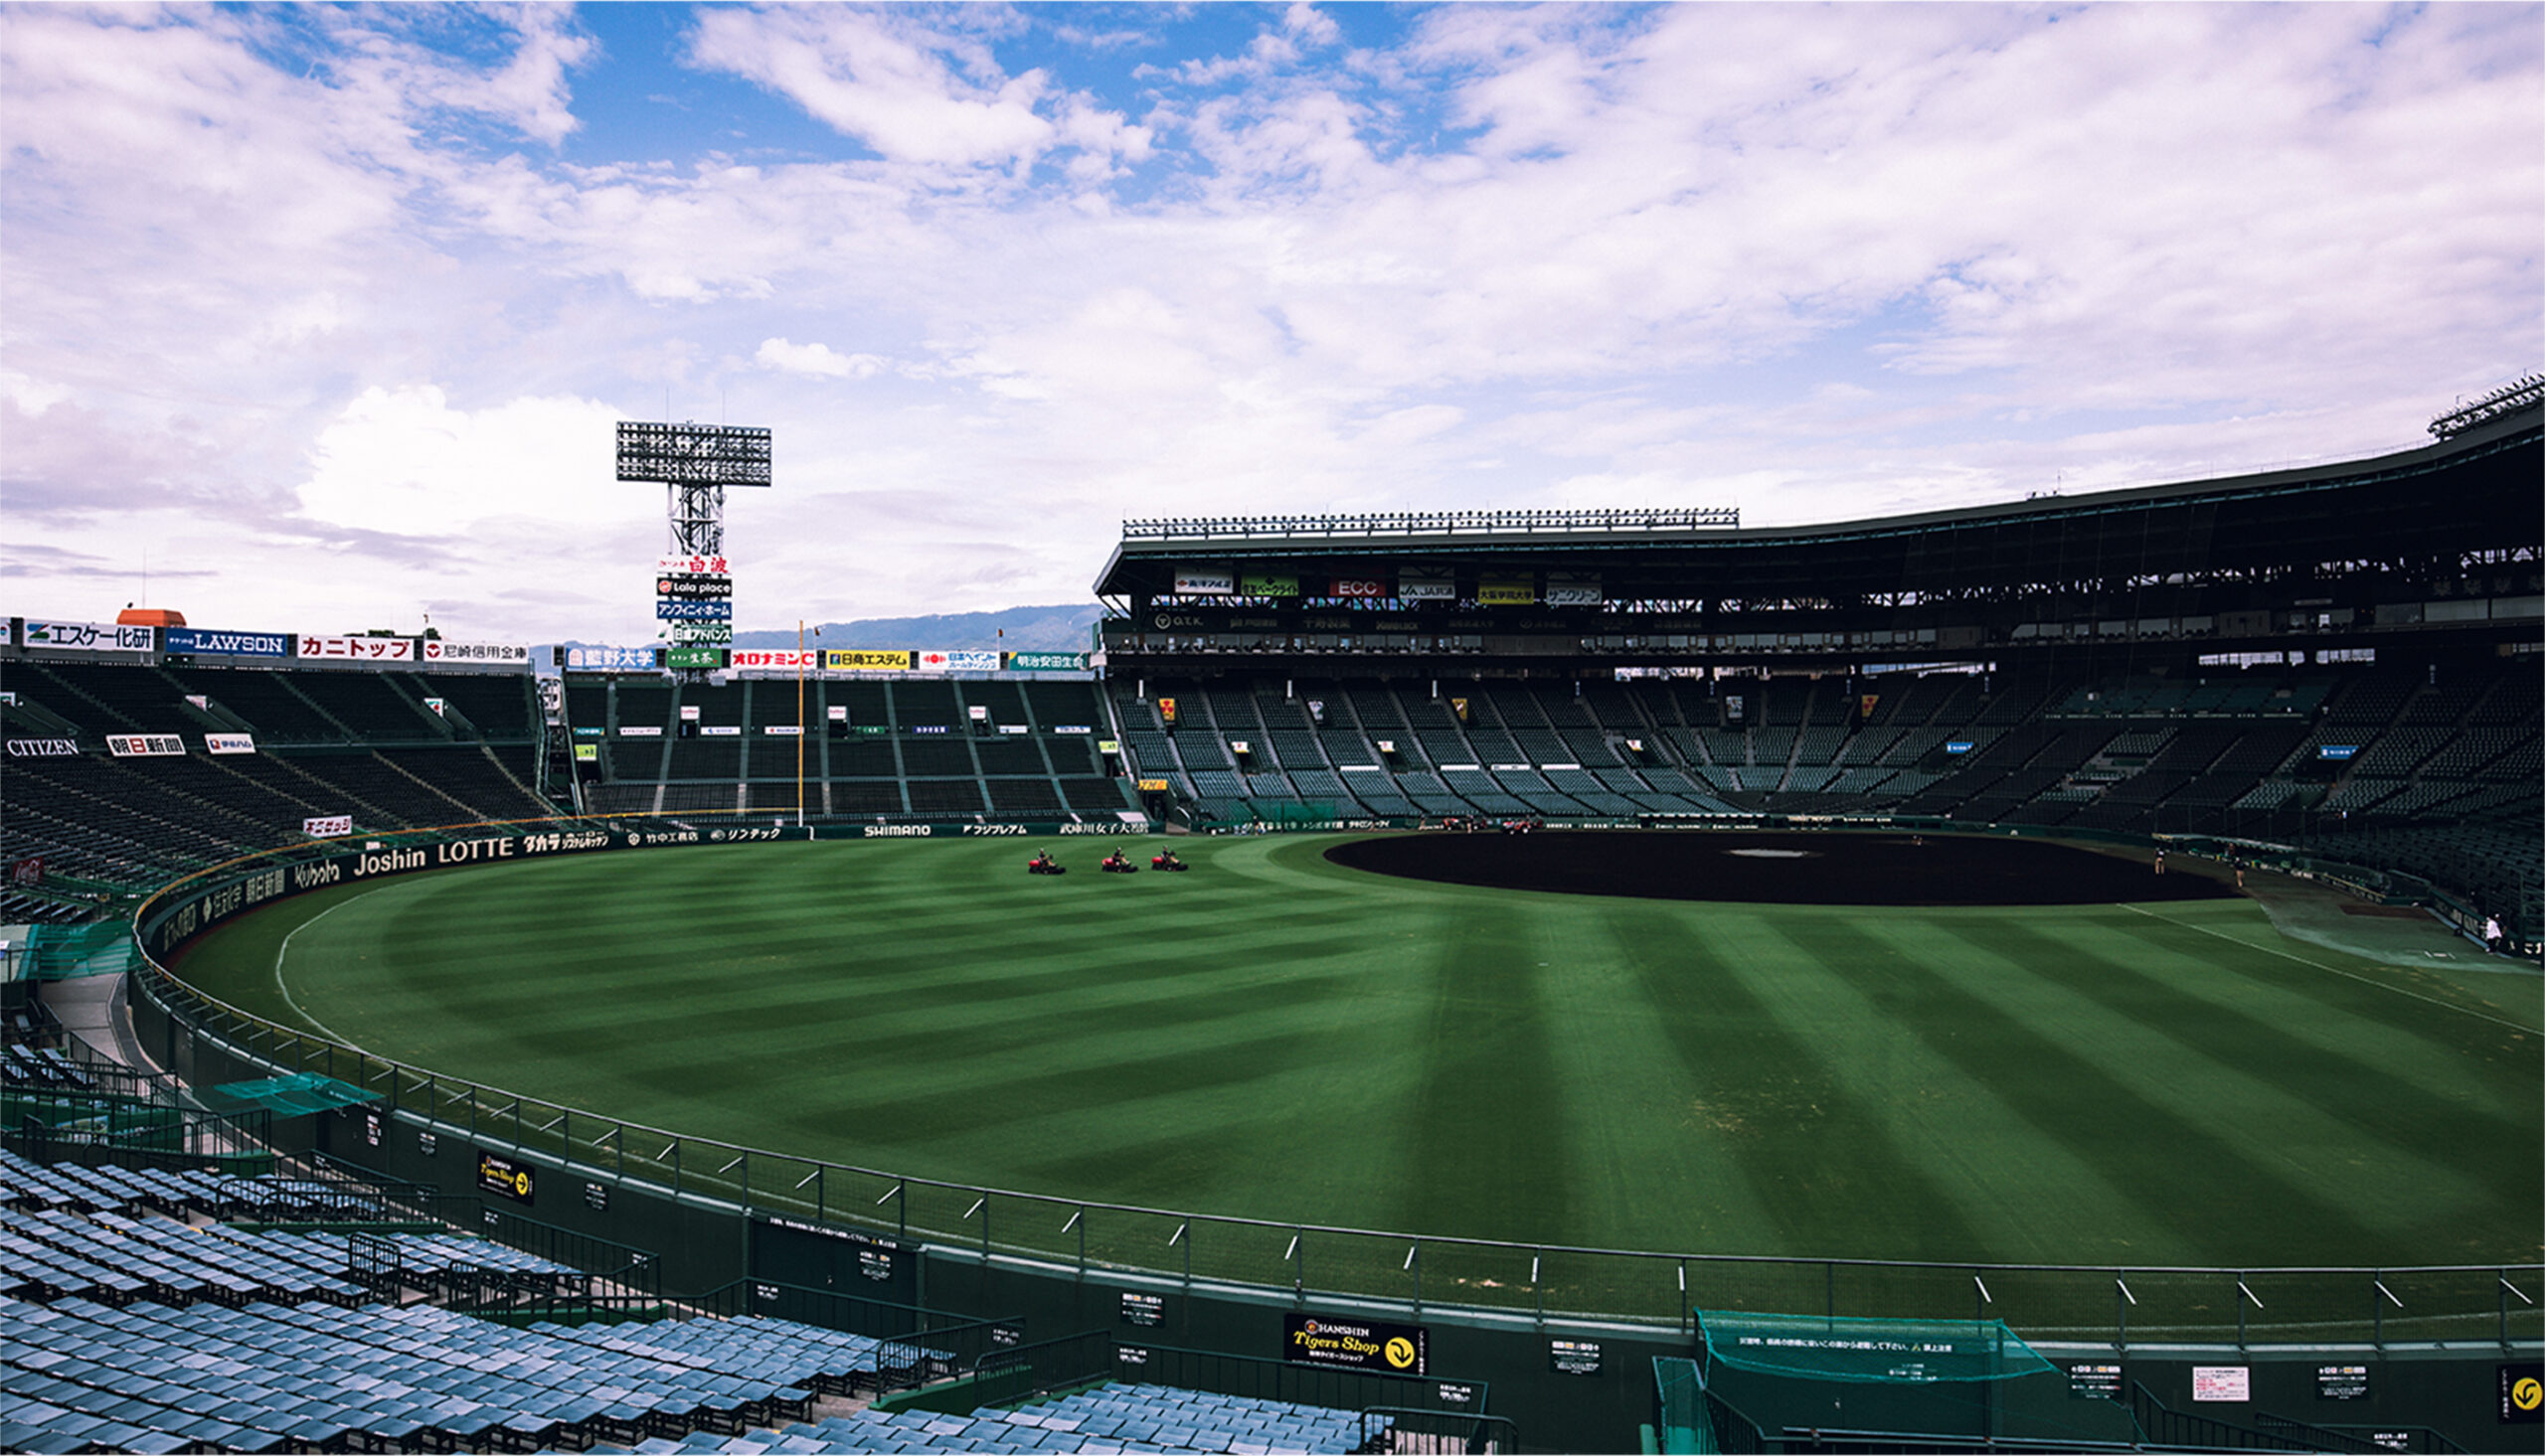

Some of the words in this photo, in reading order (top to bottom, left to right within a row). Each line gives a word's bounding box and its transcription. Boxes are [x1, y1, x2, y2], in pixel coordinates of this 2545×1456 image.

[689, 556, 729, 573] 白波
[1338, 581, 1378, 595] ECC
[50, 625, 152, 649] エスケー化研
[194, 633, 283, 653] LAWSON
[302, 636, 410, 660] カニトップ
[443, 645, 527, 660] 尼崎信用金庫
[585, 649, 654, 667] 藍野大学
[733, 652, 814, 666] オロナミンC
[842, 652, 907, 666] 日商エステム
[1017, 654, 1085, 669] 明治安田生命
[6, 738, 80, 757] CITIZEN
[110, 737, 184, 754] 朝日新聞
[728, 828, 781, 840] リンテック
[864, 825, 932, 837] SHIMANO
[438, 837, 514, 864] LOTTE
[523, 833, 560, 853] タカラ
[353, 848, 425, 877] Joshin
[294, 859, 340, 889] Kubota
[246, 869, 286, 905] 朝日新聞
[1318, 1324, 1369, 1336] HANSHIN
[1293, 1330, 1339, 1350] Tigers
[1342, 1336, 1379, 1355] Shop
